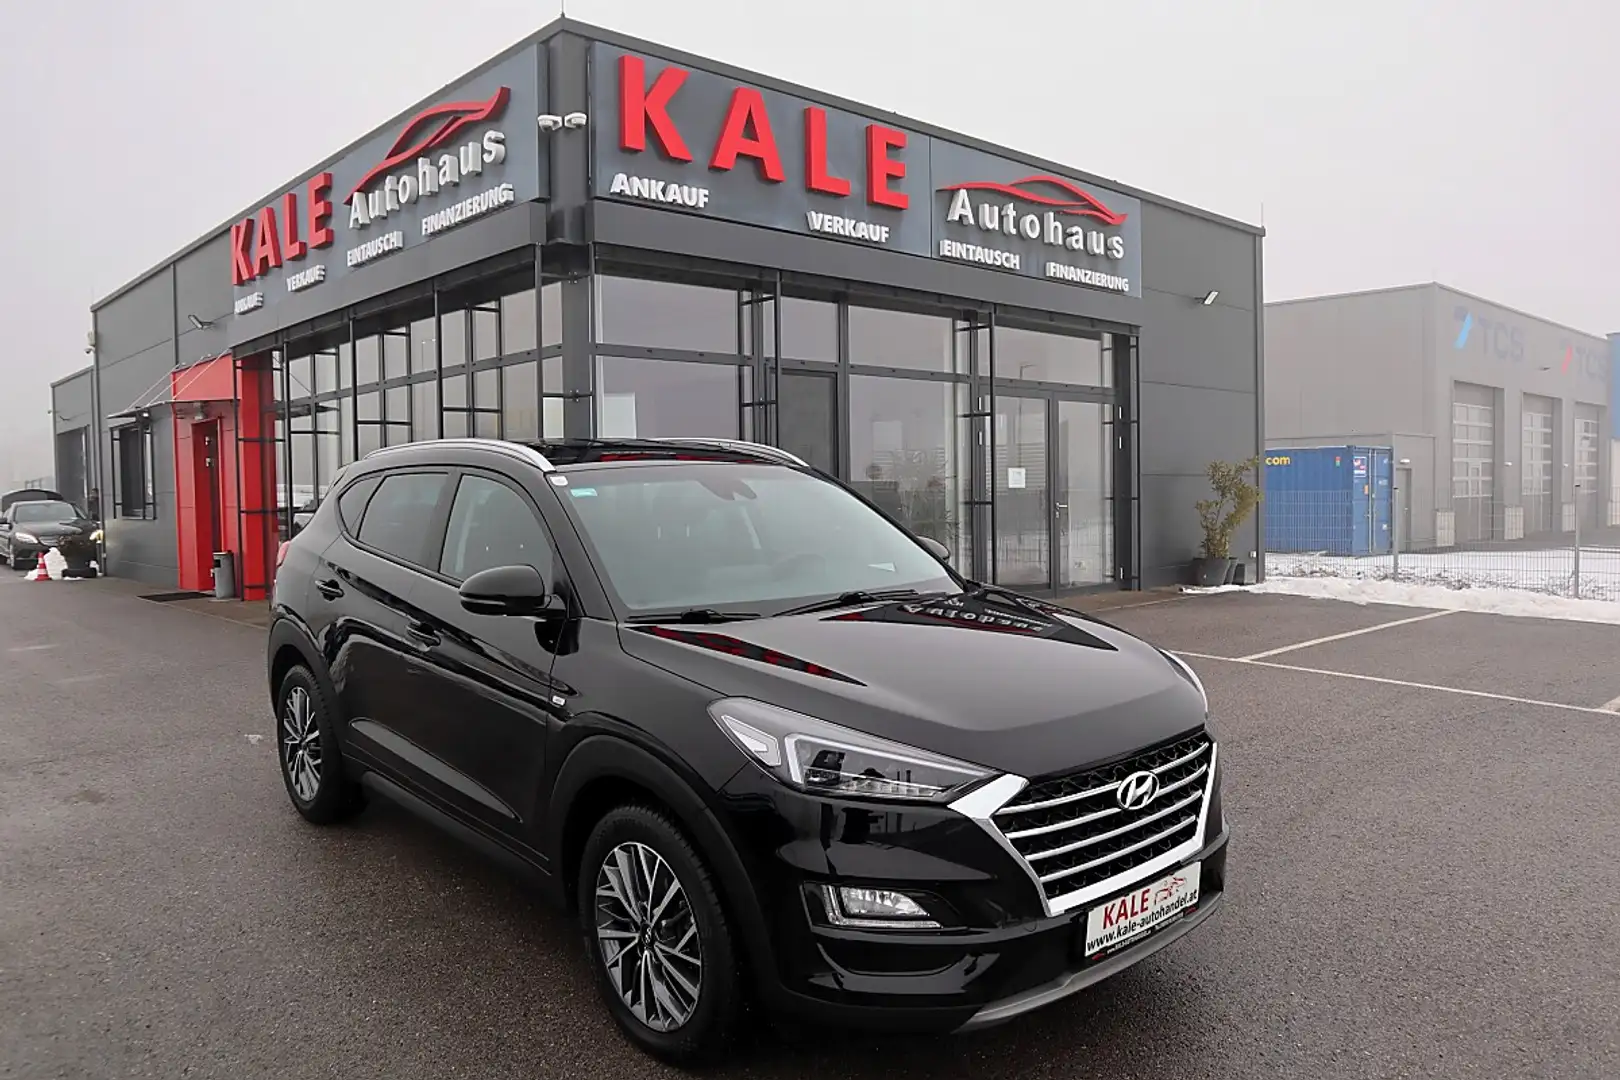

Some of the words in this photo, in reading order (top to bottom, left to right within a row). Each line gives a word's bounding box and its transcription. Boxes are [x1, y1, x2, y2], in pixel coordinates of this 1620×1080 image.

[617, 54, 909, 210] KALE
[349, 129, 507, 229] Autohaus
[610, 173, 709, 208] ANKAUF
[230, 172, 334, 285] KALE
[422, 183, 514, 236] FINANZIERUNG
[805, 211, 890, 243] VERKAUF
[946, 188, 1125, 260] Autohaus
[347, 230, 404, 268] EINTAUSCH
[940, 239, 1020, 270] EINTAUSCH
[1046, 261, 1129, 292] FINANZIERUNG
[1478, 315, 1524, 363] TCS
[1087, 889, 1198, 952] www.kale-autohandel.at
[1103, 889, 1150, 930] KALE
